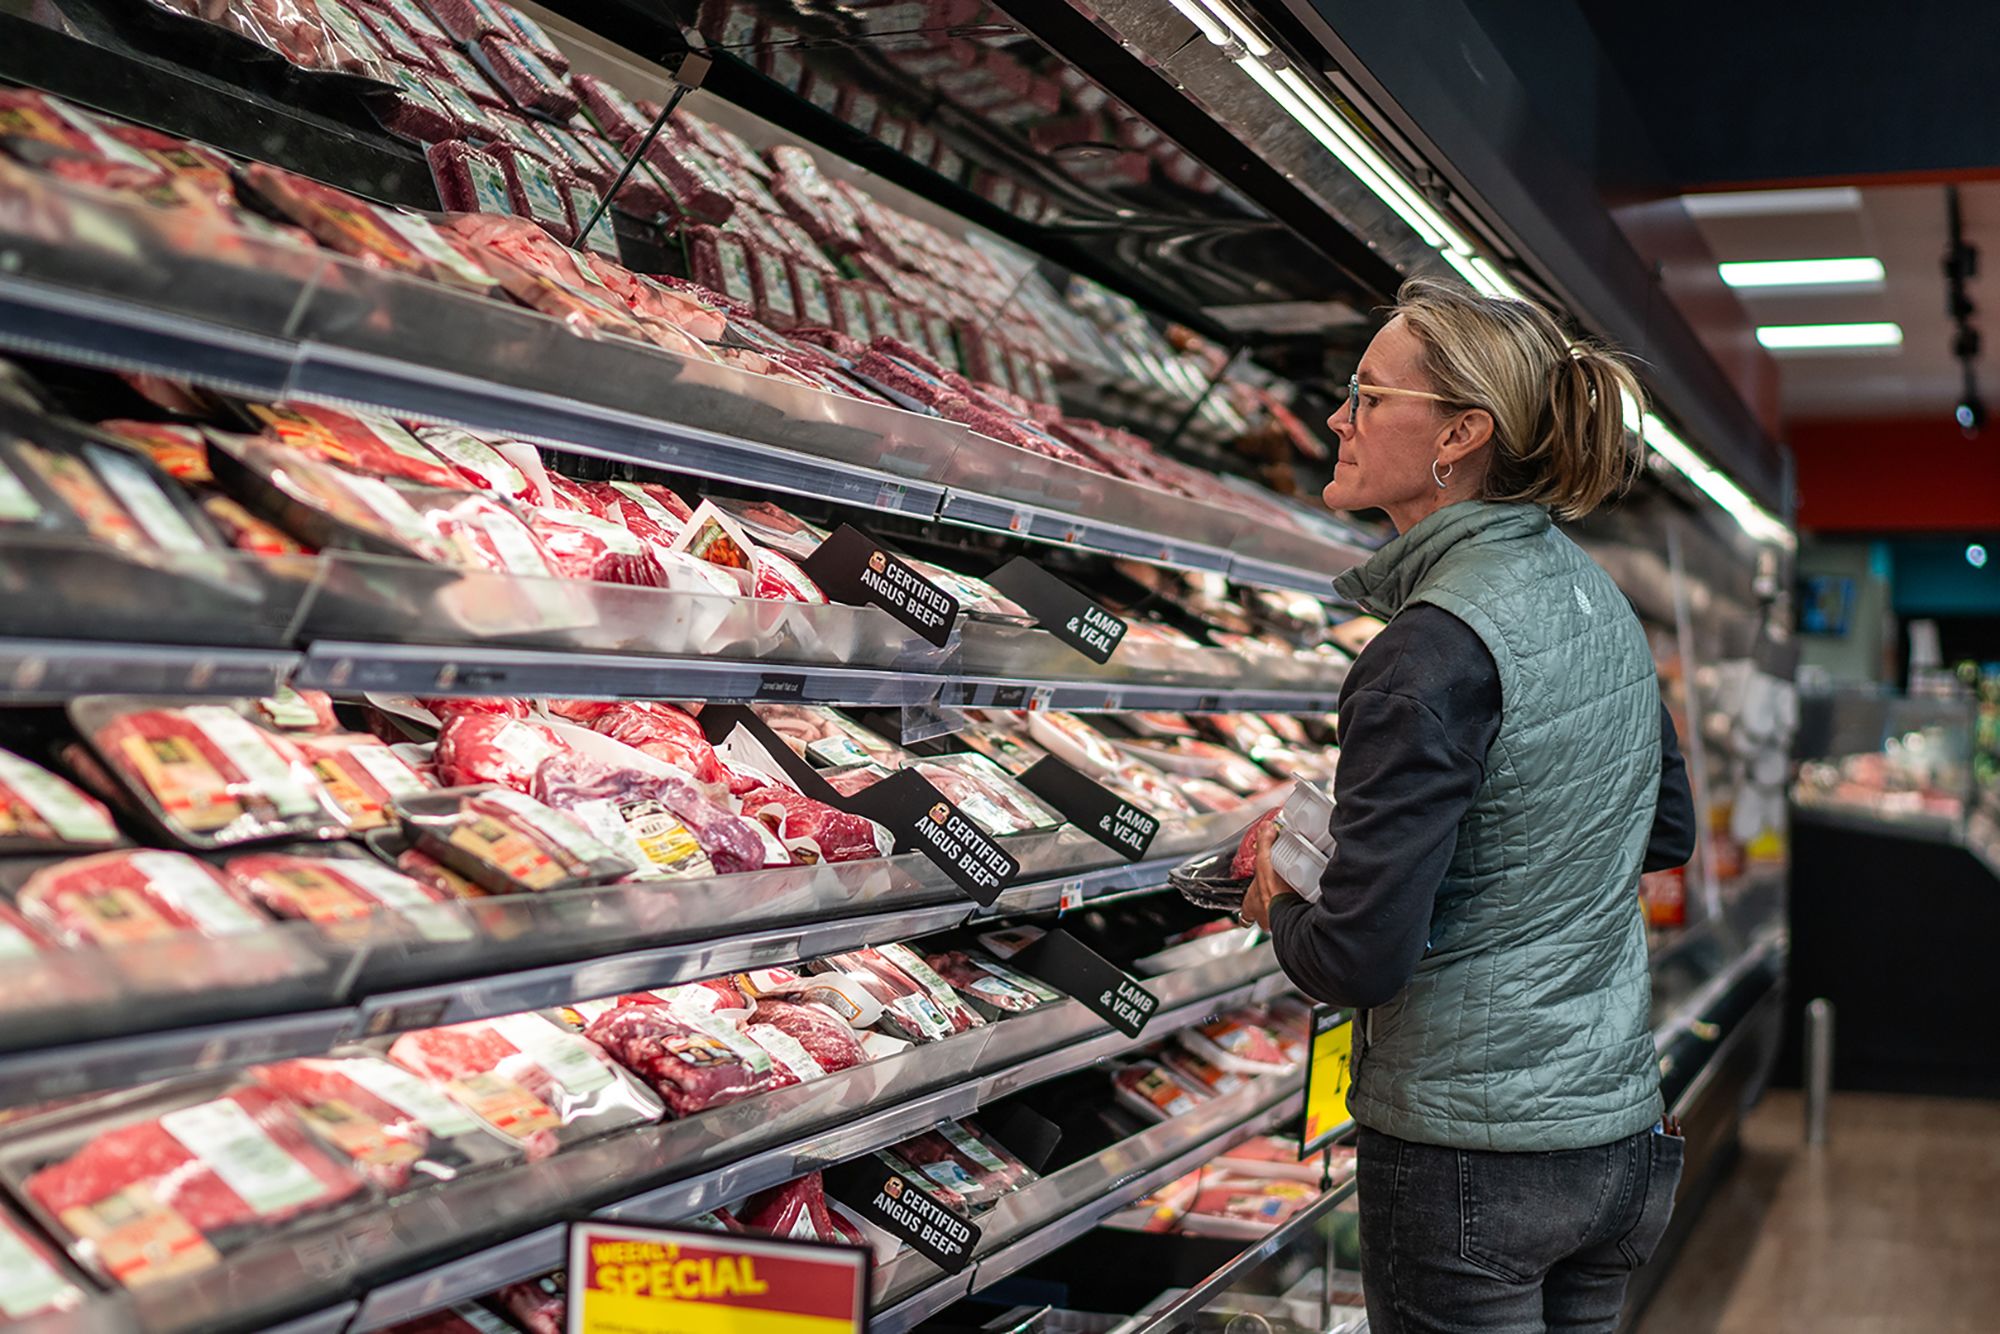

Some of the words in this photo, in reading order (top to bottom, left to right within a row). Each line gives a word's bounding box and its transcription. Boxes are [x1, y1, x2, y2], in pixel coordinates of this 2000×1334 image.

[860, 568, 906, 606] ANGUS
[886, 563, 950, 614] CERTIFIED
[1066, 616, 1079, 633] &
[1080, 623, 1111, 653] VEAL
[1084, 607, 1122, 637] LAMB
[914, 815, 962, 860] ANGUS
[1099, 815, 1111, 831] &
[1113, 822, 1143, 851] VEAL
[1115, 804, 1154, 835] LAMB
[946, 816, 1011, 877] CERTIFIED
[1100, 990, 1112, 1006] &
[1112, 997, 1142, 1028] VEAL
[1117, 981, 1153, 1012] LAMB
[872, 1192, 921, 1233] ANGUS
[902, 1189, 970, 1243] CERTIFIED
[592, 1242, 680, 1265] WEEKLY
[595, 1254, 768, 1298] SPECIAL
